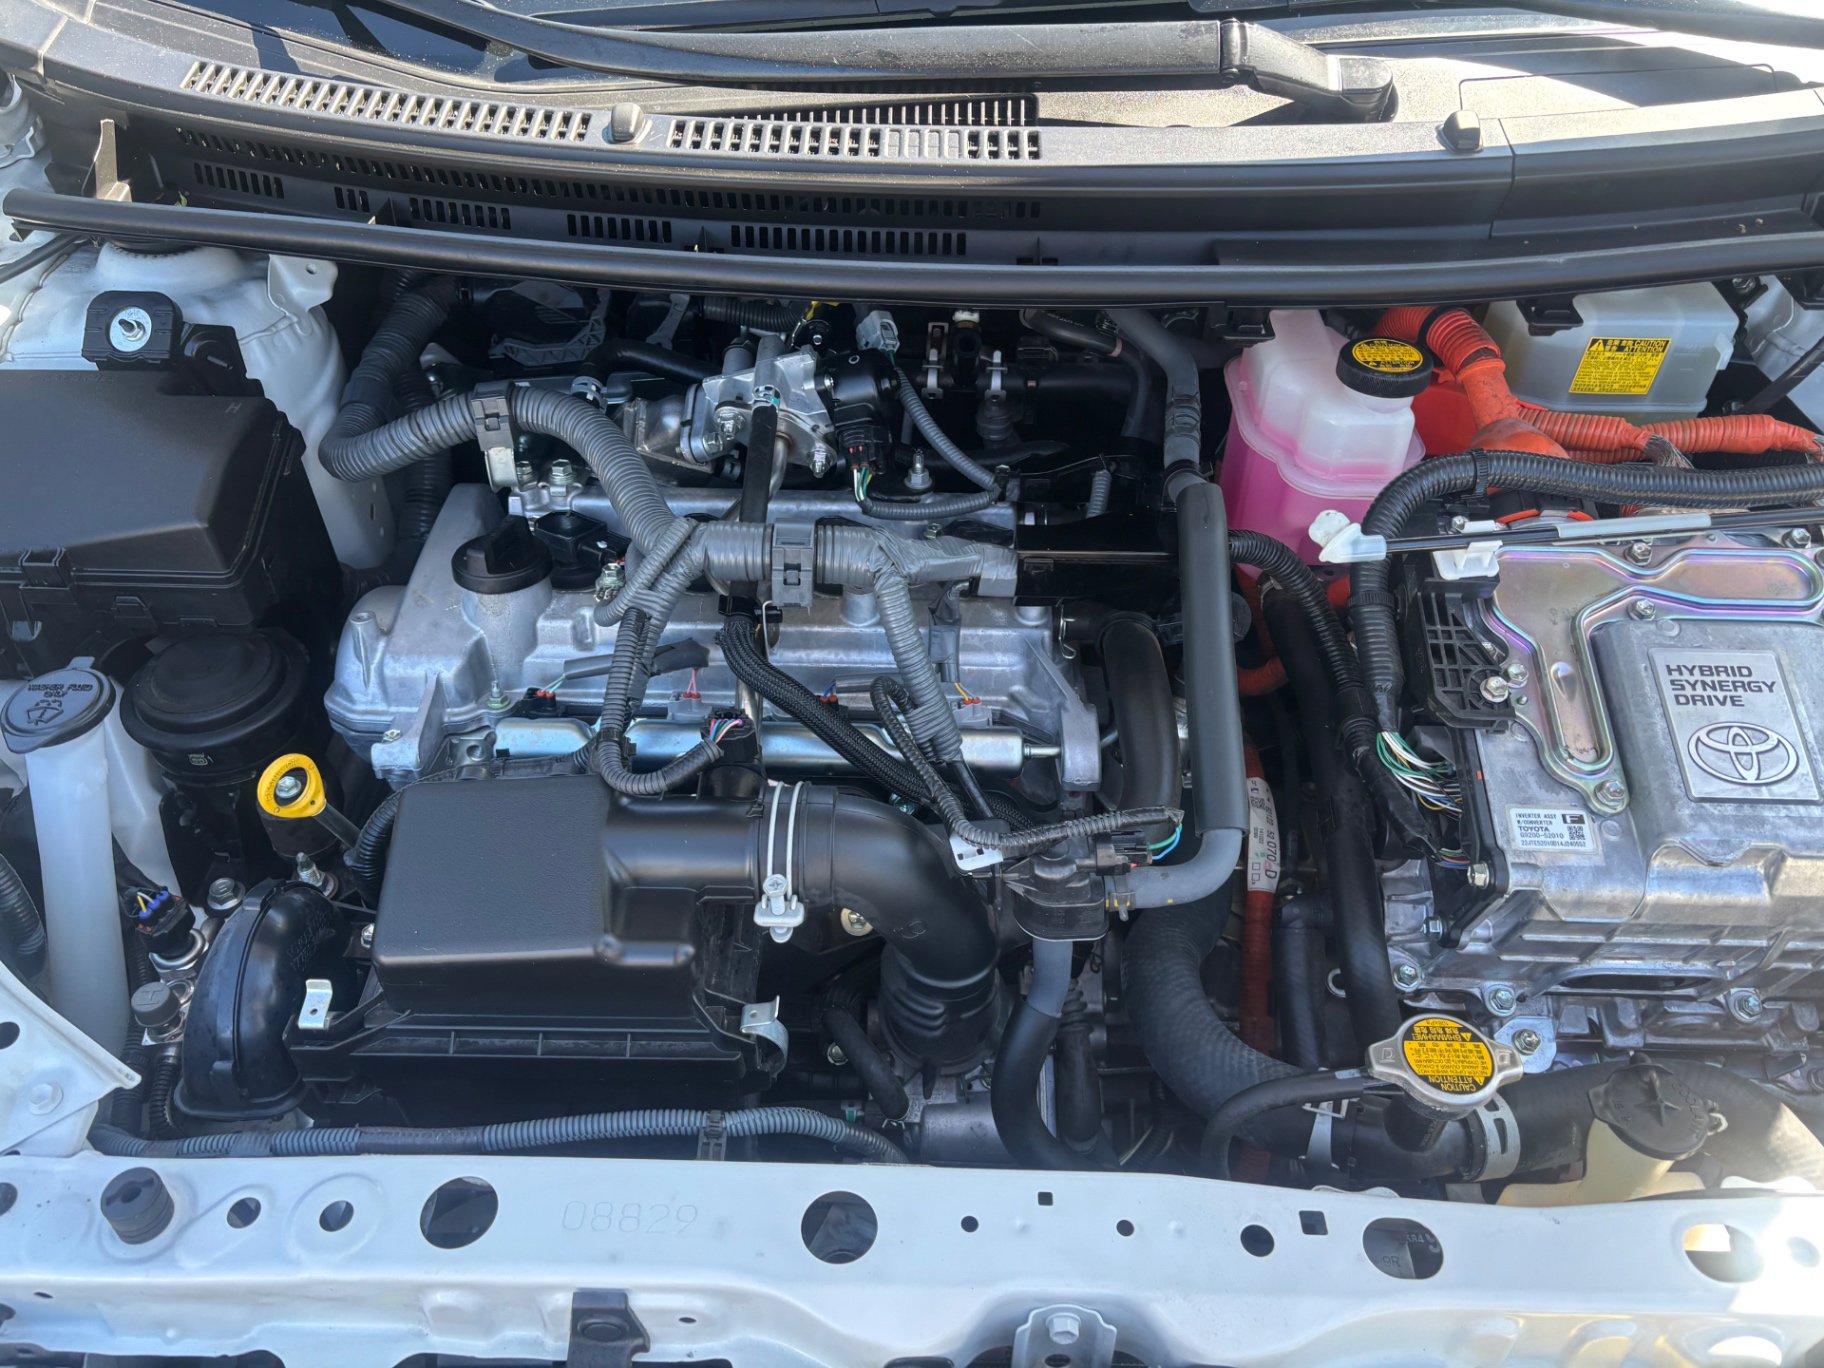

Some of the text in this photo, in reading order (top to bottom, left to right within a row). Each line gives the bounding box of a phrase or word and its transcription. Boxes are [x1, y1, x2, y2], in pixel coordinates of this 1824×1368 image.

[1665, 664, 1753, 678] HYBRID
[1669, 679, 1777, 693] SYNERGY
[1673, 694, 1745, 707] DRIVE
[1429, 1075, 1473, 1083] ATTENTION
[1441, 1084, 1477, 1092] CAUTION
[562, 1200, 698, 1235] 08829
